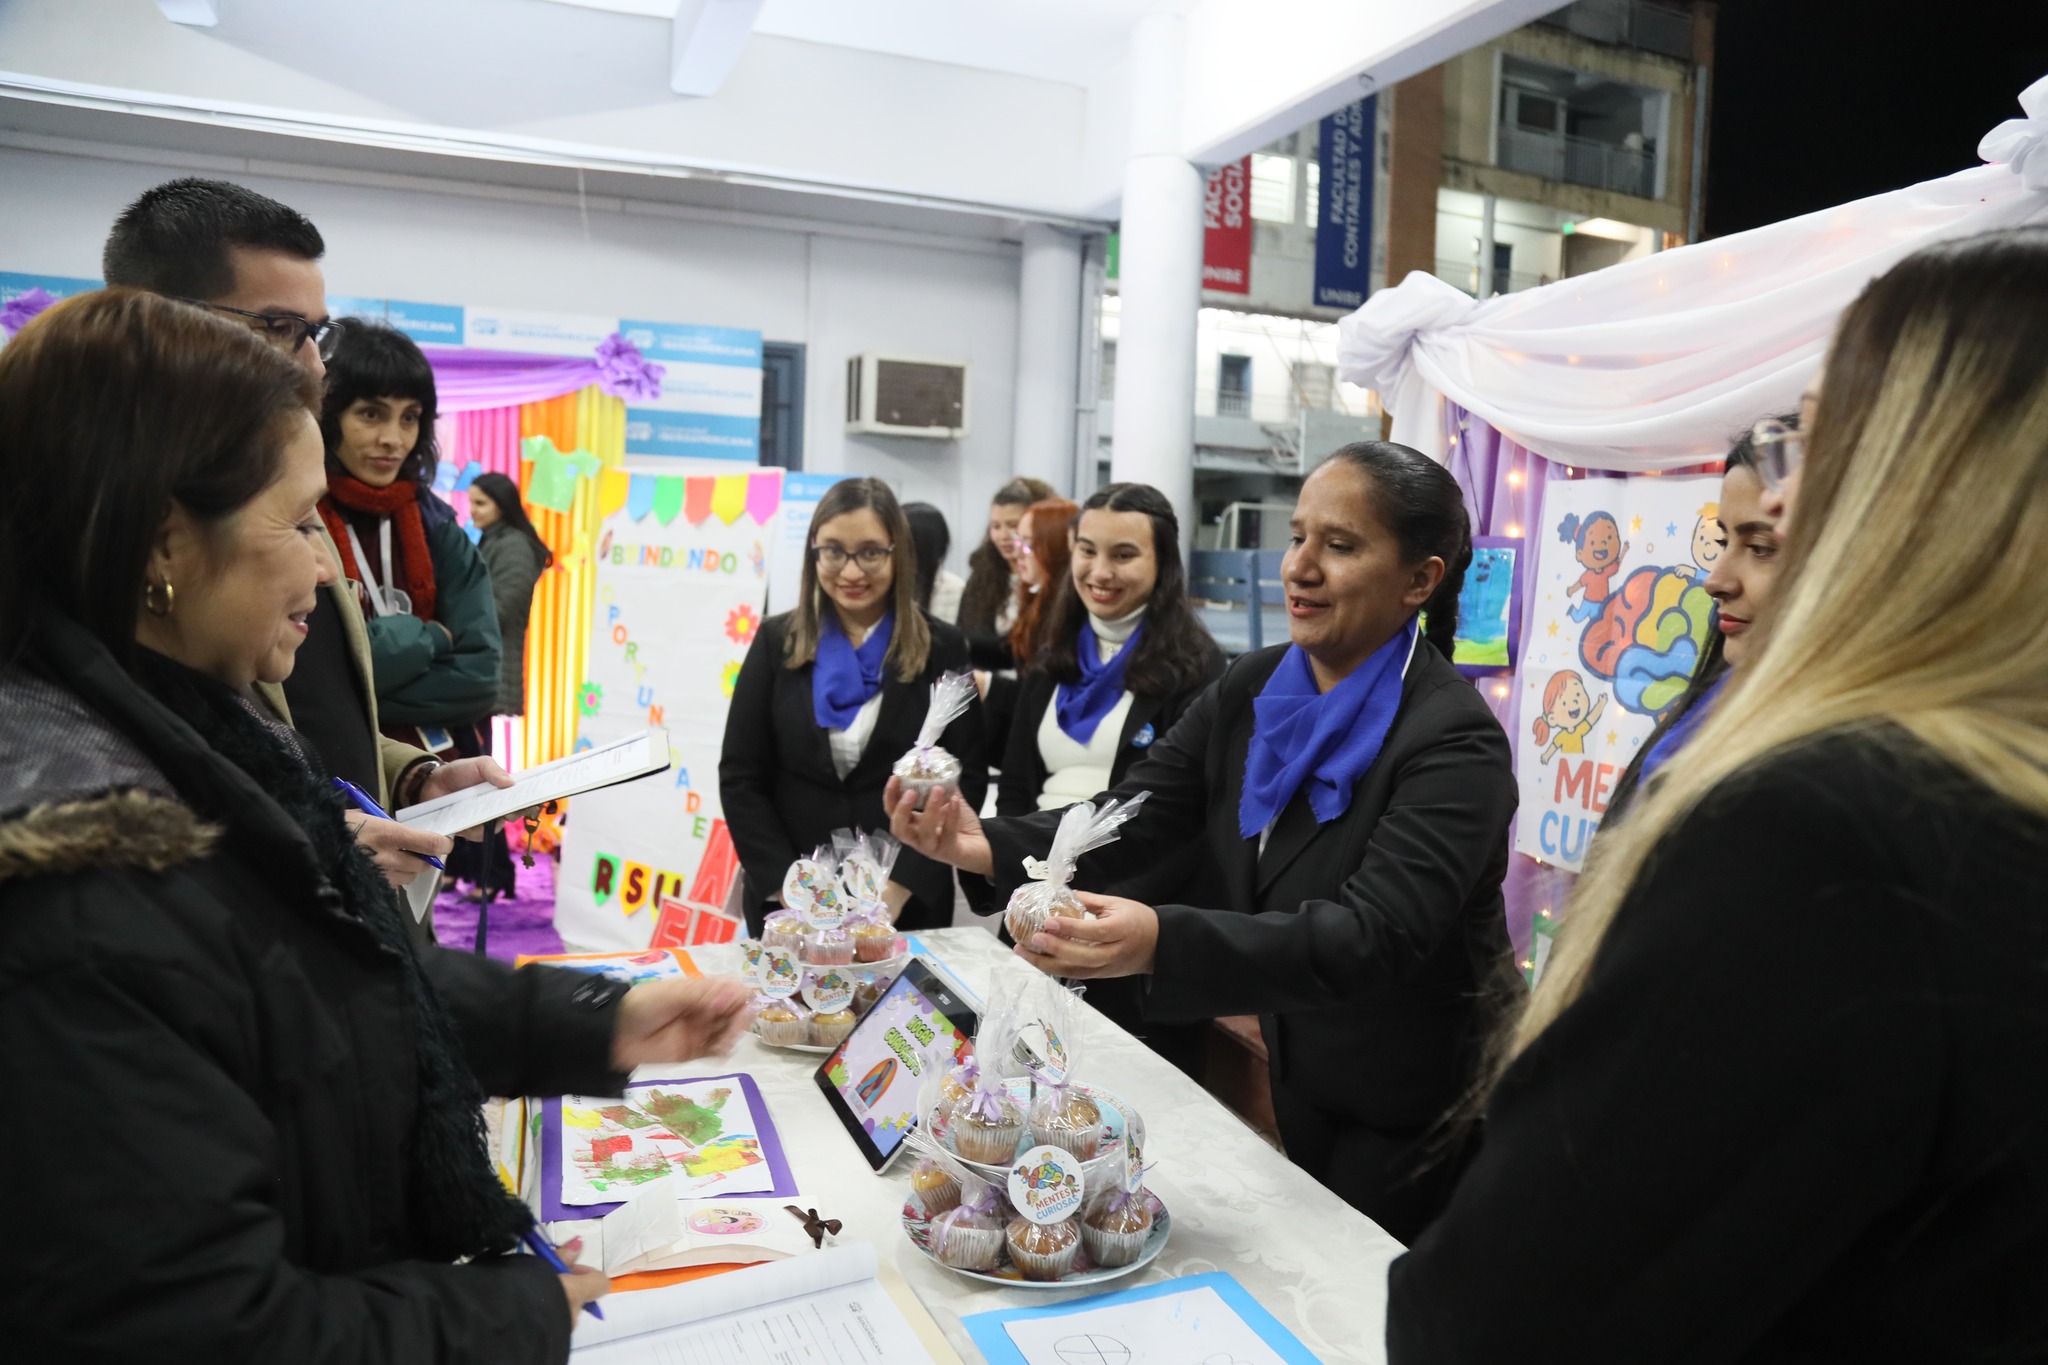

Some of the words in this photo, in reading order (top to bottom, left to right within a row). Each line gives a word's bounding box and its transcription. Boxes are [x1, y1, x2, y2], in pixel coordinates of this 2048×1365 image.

[1349, 143, 1362, 154] Y
[1330, 131, 1347, 225] FACULTAD
[1343, 158, 1362, 268] CONTABLES
[1320, 287, 1362, 307] UNIBE
[612, 545, 737, 574] BRINDANDO
[1554, 757, 1627, 813] ME
[906, 1014, 935, 1047] HOGAR
[1035, 1188, 1071, 1210] MENTES
[1036, 1195, 1079, 1220] CURIOSAS
